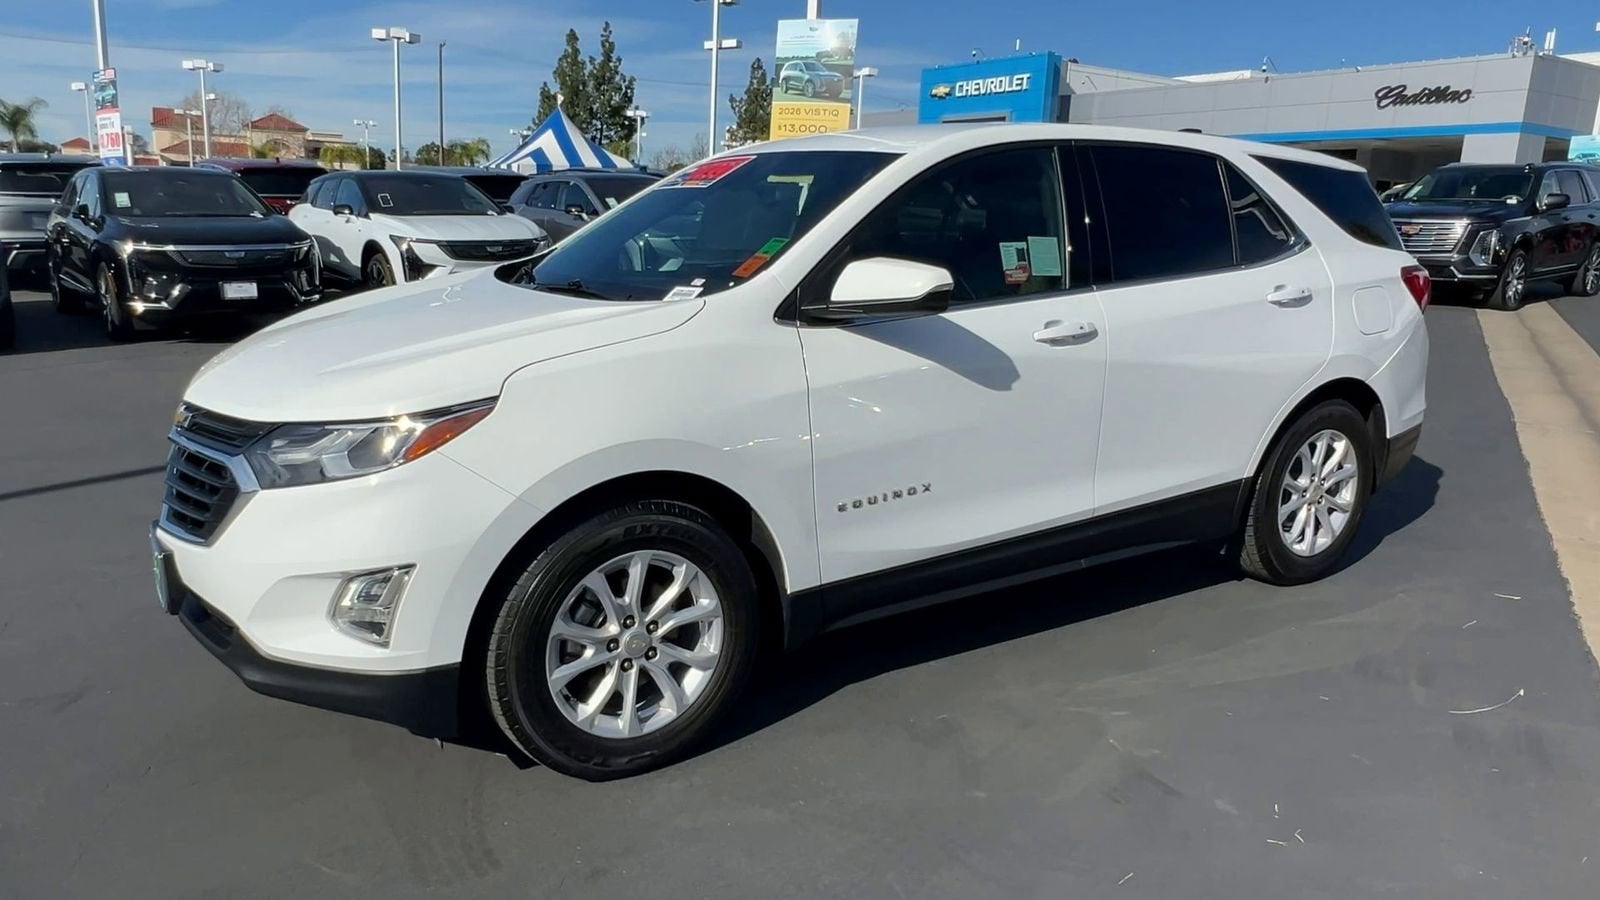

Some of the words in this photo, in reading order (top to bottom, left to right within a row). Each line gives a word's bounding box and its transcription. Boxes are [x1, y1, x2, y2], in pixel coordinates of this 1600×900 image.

[955, 73, 1031, 97] CHEVROLET
[1375, 84, 1472, 110] Cadillac
[804, 108, 840, 118] VISTIQ
[837, 483, 931, 512] EQUINOX
